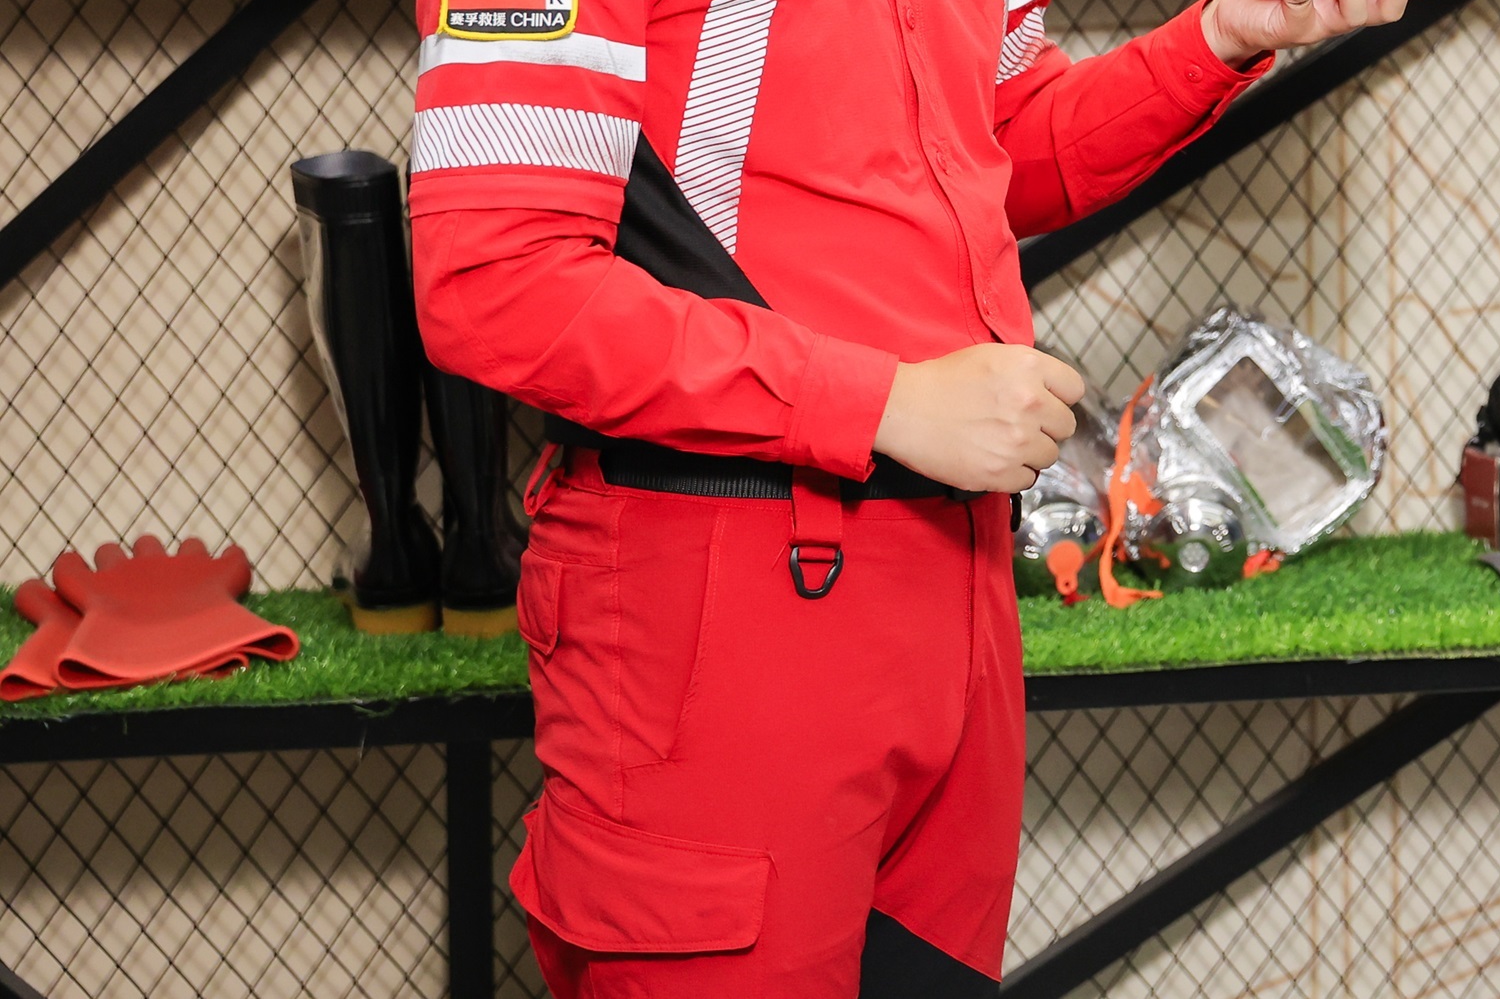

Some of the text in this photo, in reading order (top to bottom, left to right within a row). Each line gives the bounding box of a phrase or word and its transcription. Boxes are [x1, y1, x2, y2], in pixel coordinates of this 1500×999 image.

[450, 11, 565, 27] 赛孚救援 CHINA
